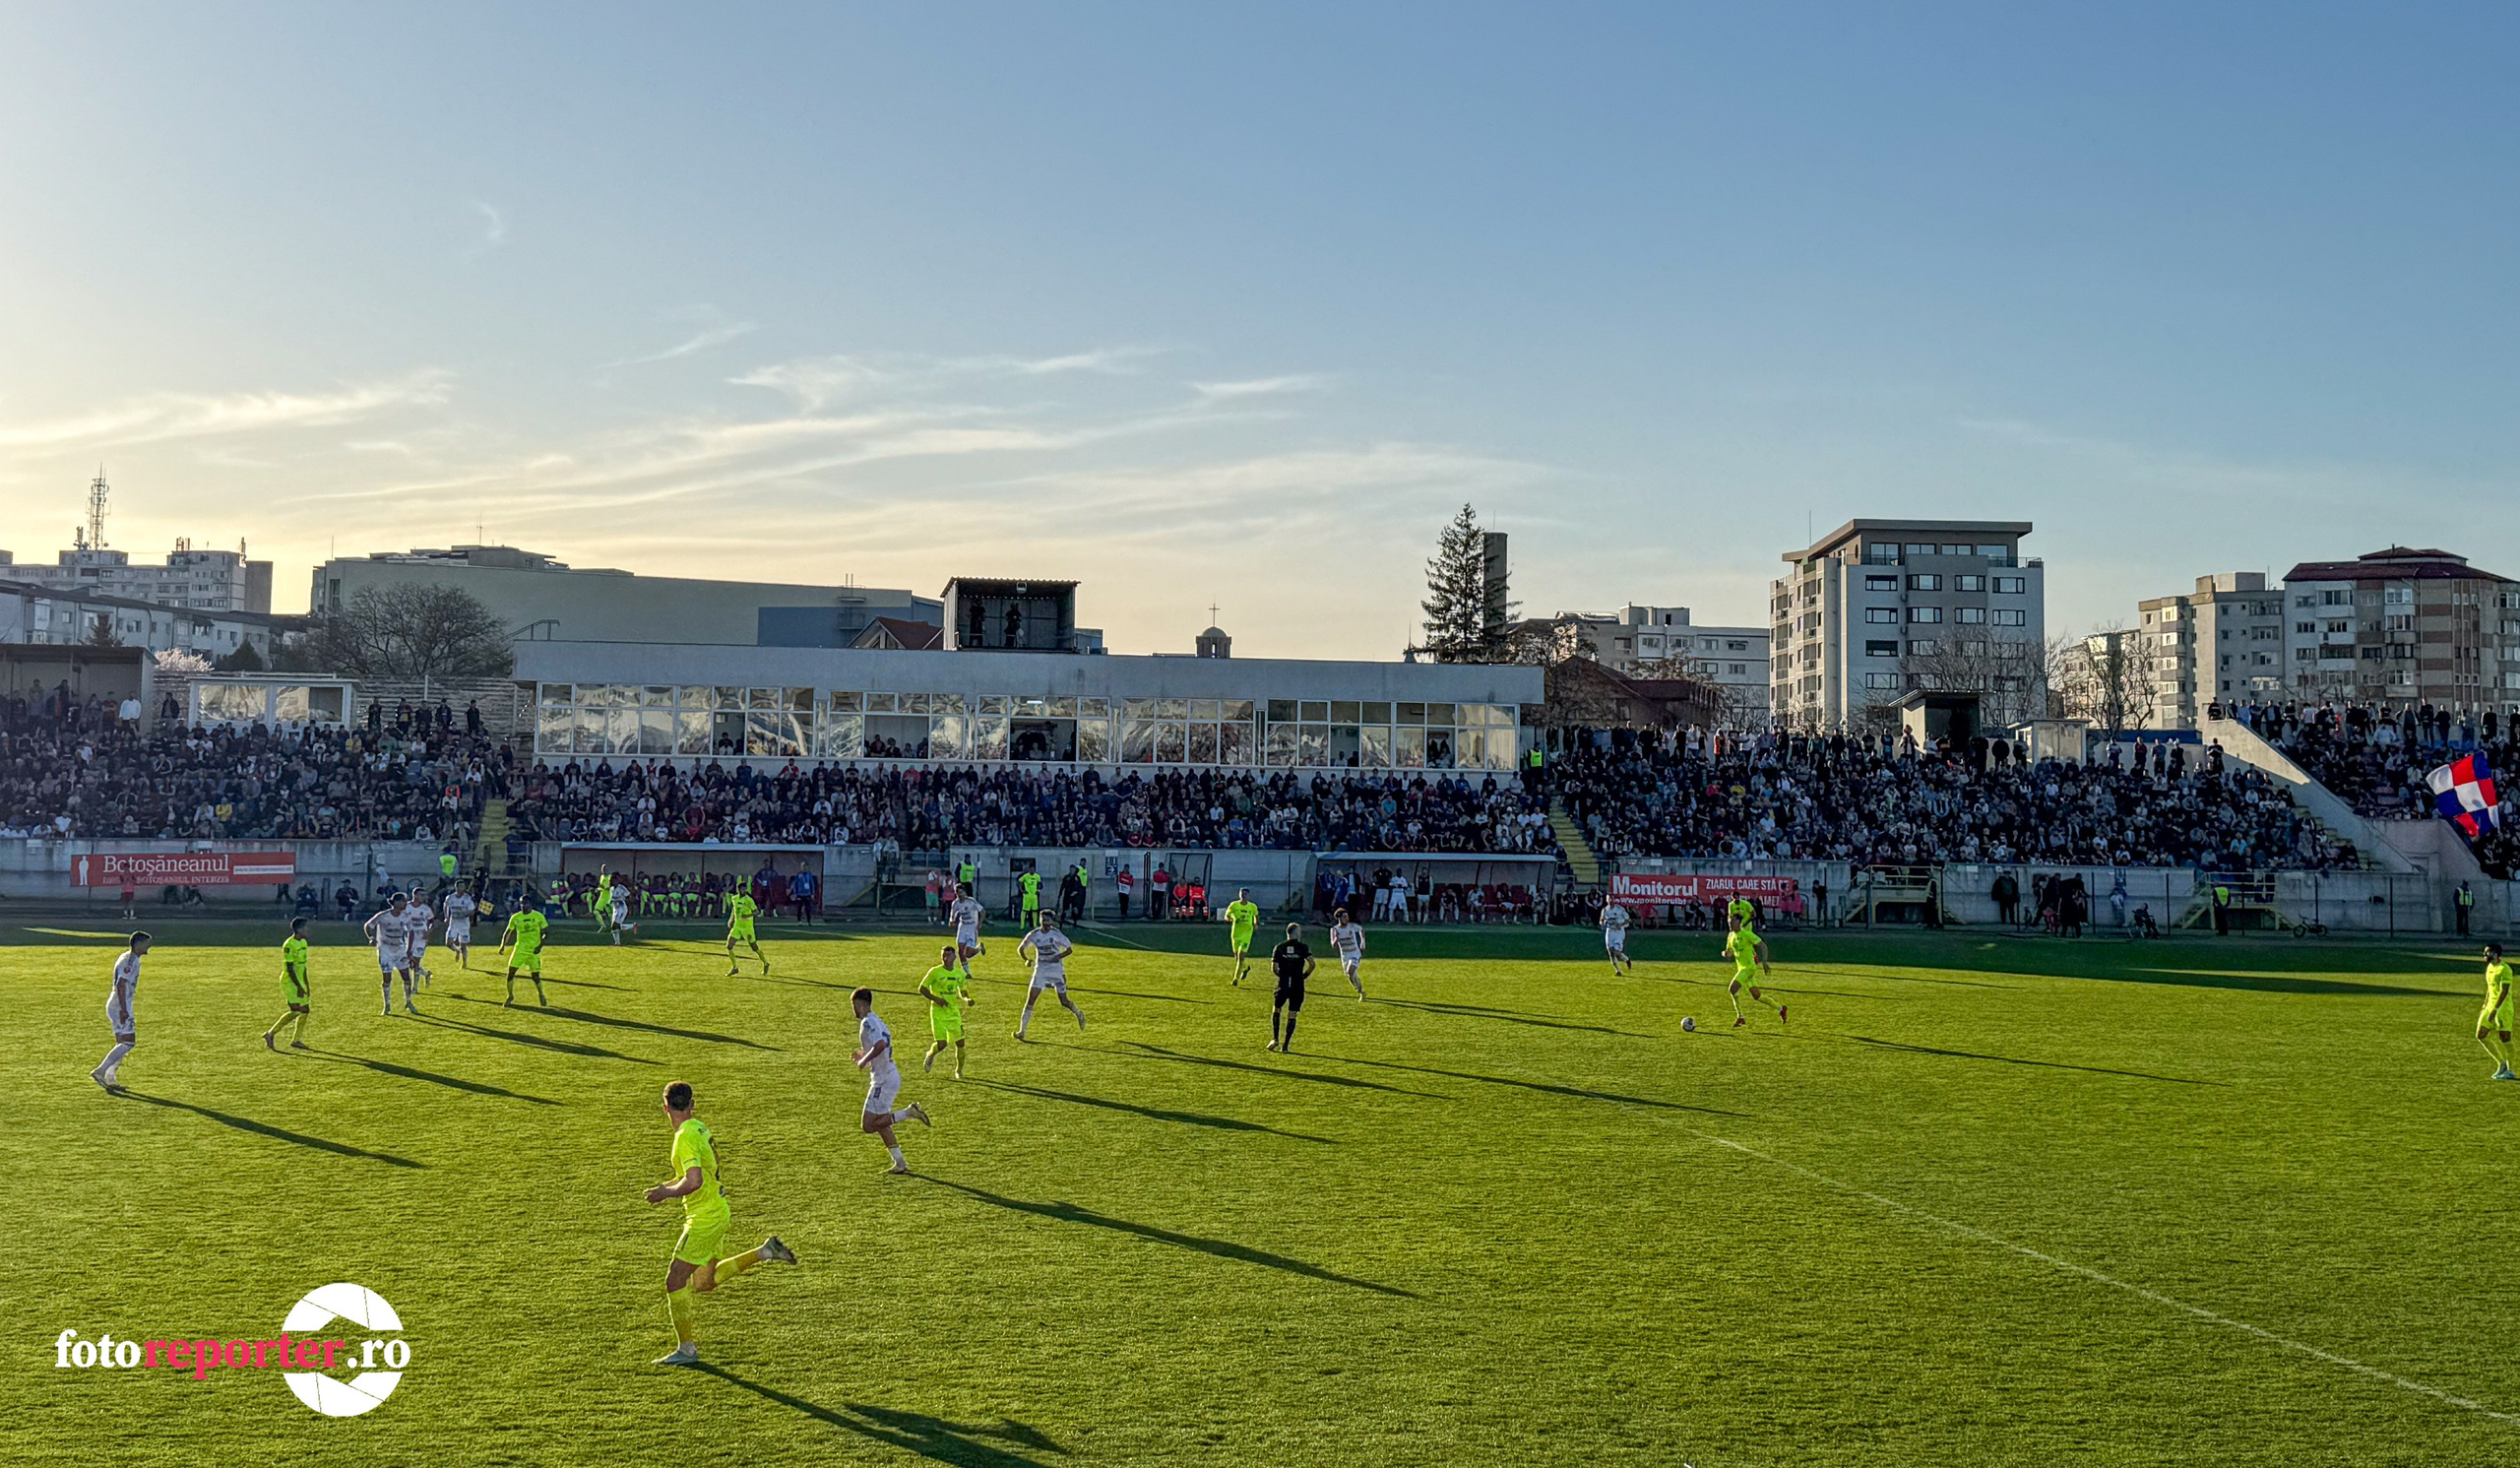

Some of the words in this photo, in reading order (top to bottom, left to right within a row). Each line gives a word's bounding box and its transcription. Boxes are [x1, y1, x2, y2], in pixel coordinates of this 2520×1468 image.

[1612, 875, 1698, 896] Monitorul
[1706, 878, 1734, 889] ZIARUL
[1736, 878, 1760, 890] CARE
